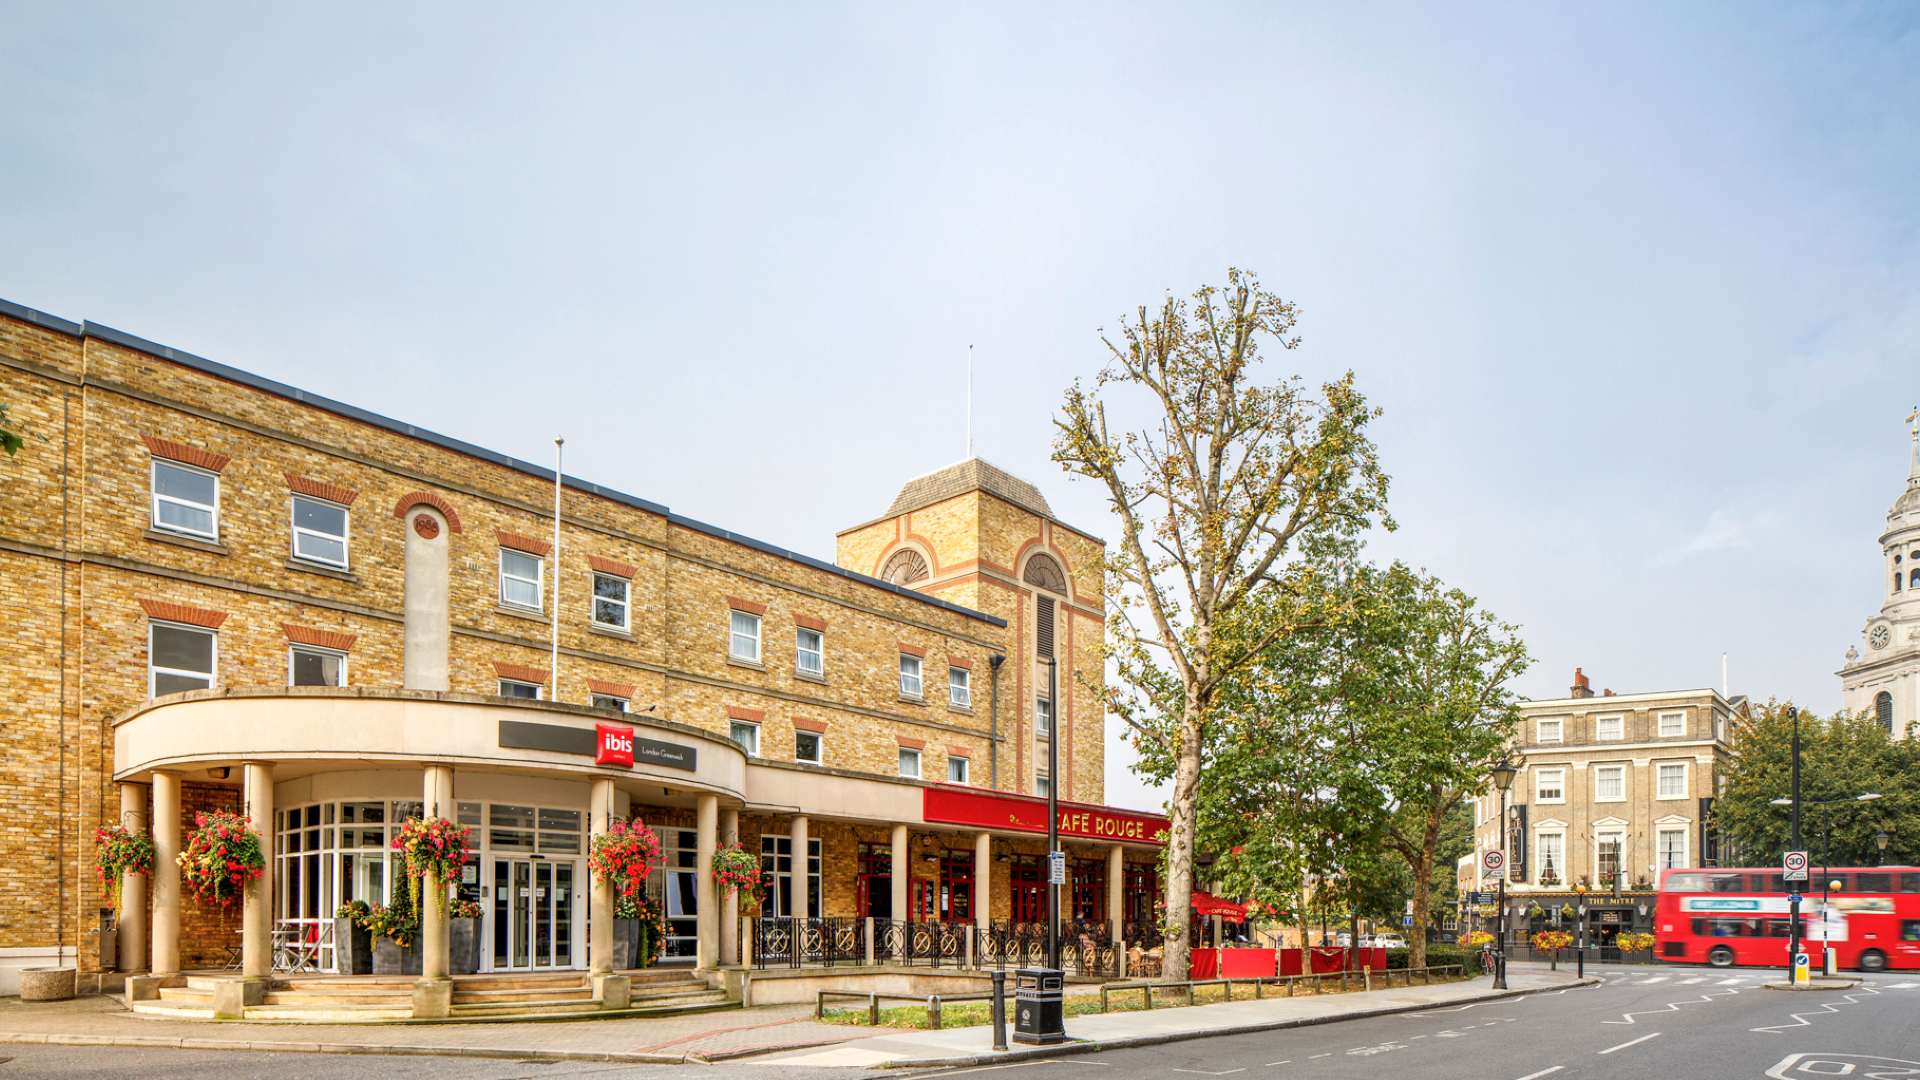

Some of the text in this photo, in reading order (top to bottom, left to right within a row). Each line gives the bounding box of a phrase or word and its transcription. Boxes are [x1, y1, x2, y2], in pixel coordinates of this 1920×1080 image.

[415, 518, 438, 533] 1988
[605, 733, 632, 753] ibis
[642, 746, 684, 761] London Greenwich
[1095, 817, 1144, 838] ROUGE
[1588, 897, 1635, 905] THE MITRE
